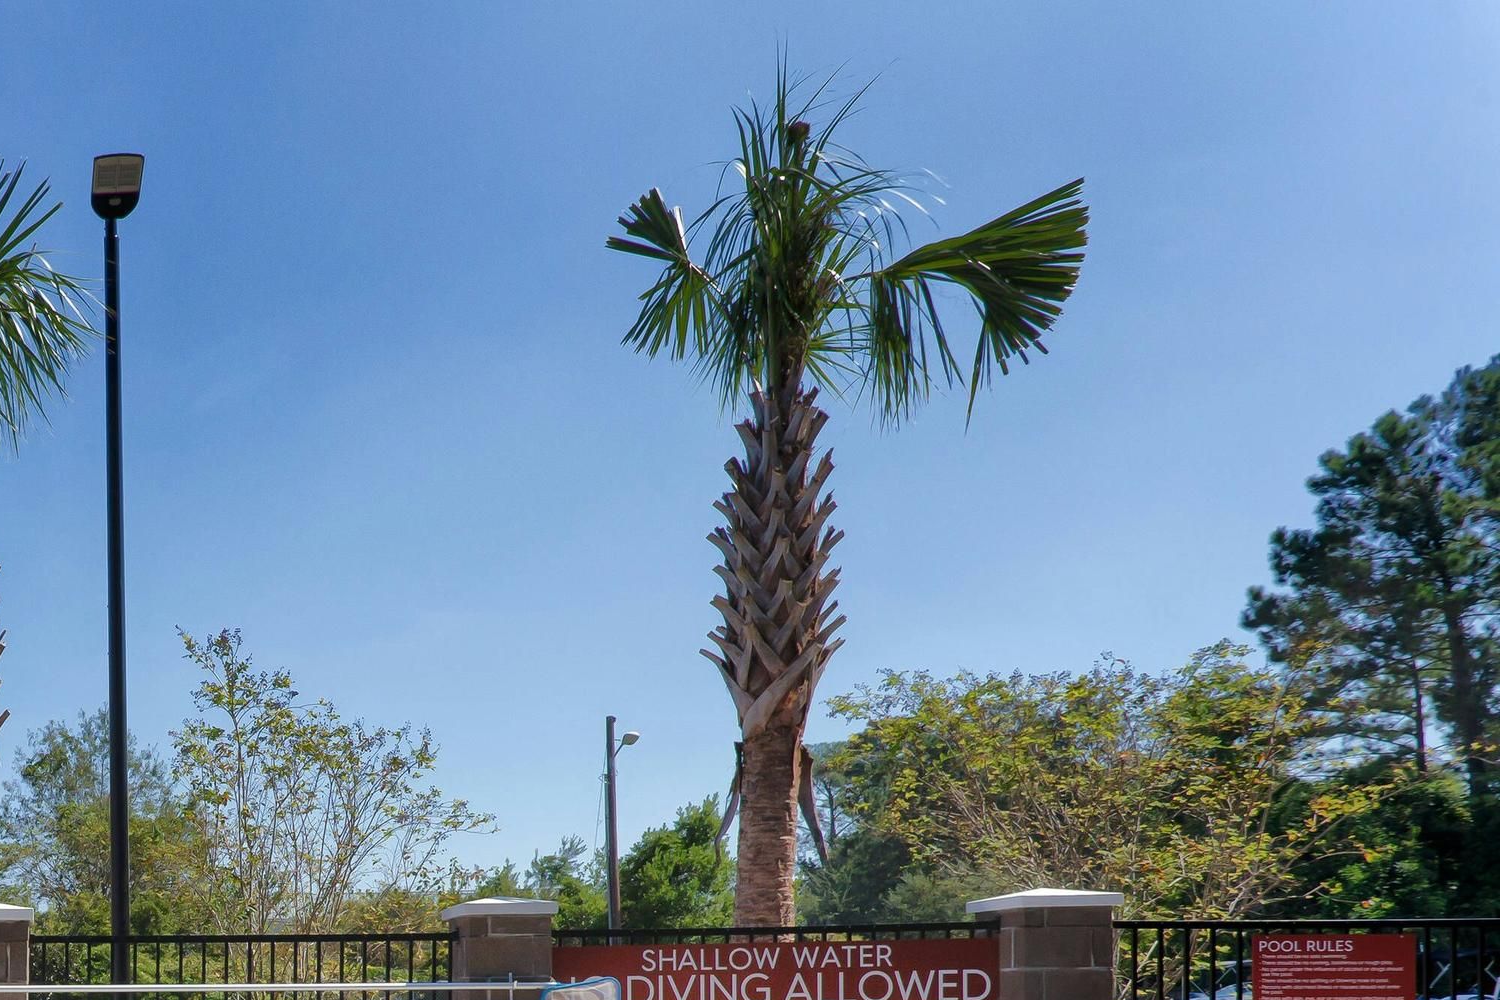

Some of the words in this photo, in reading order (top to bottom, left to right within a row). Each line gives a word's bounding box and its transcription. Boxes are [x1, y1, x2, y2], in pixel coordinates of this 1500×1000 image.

[1259, 940, 1301, 952] POOL
[1306, 940, 1353, 952] RULES
[641, 946, 780, 972] SHALLOW
[792, 944, 893, 969] WATER
